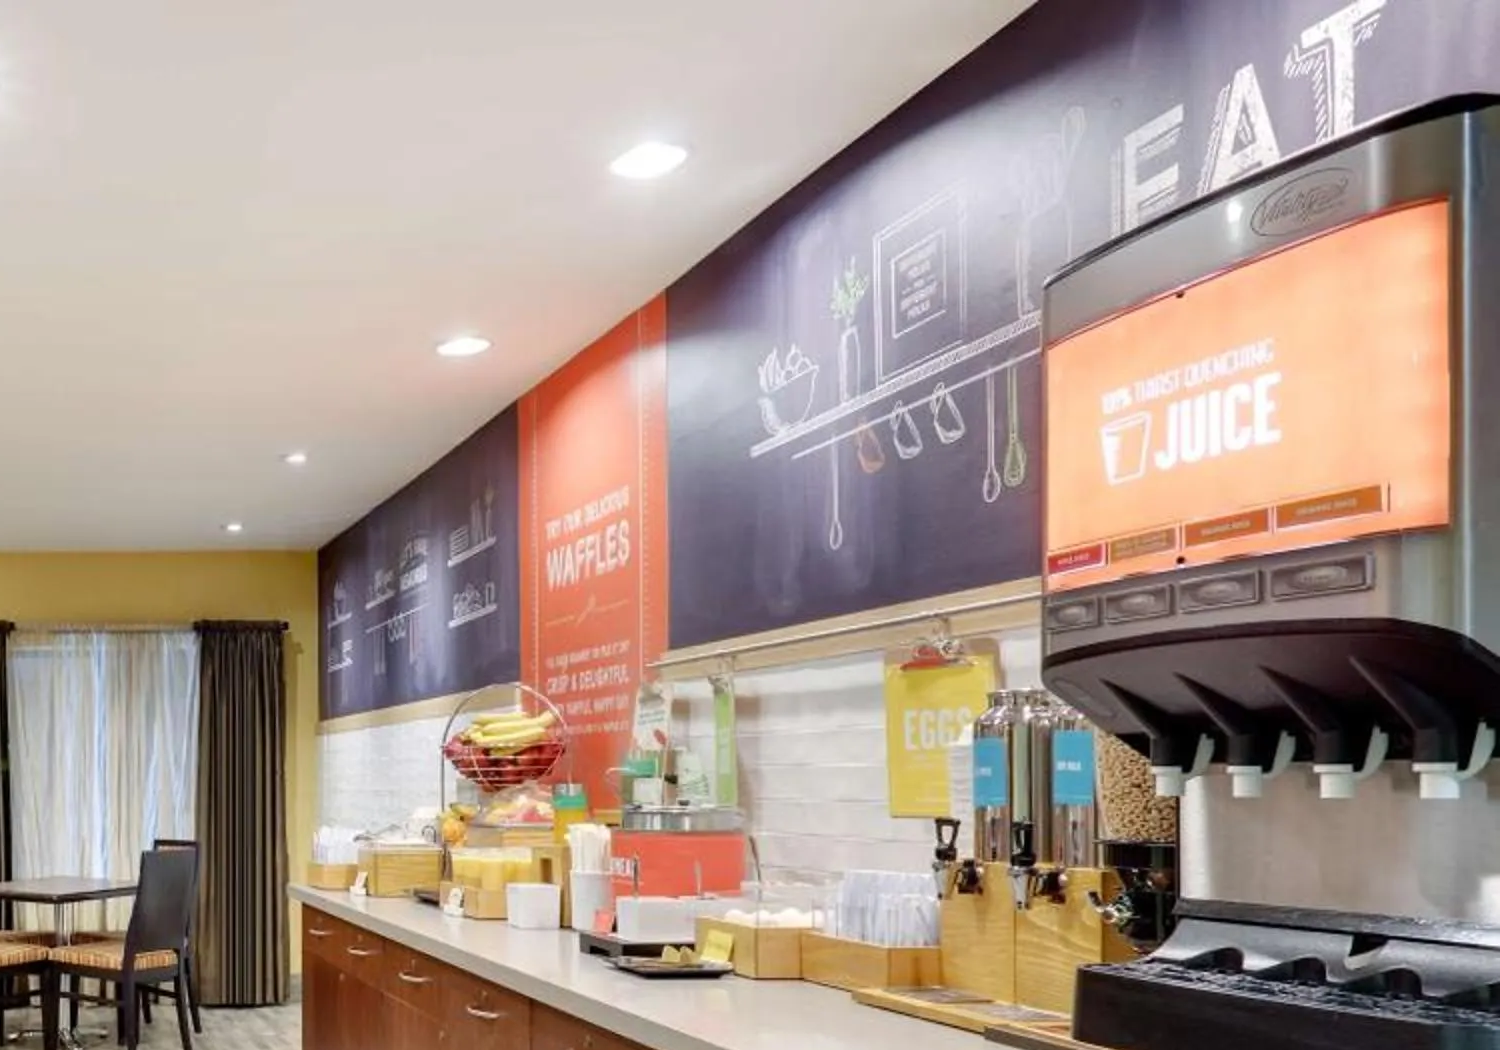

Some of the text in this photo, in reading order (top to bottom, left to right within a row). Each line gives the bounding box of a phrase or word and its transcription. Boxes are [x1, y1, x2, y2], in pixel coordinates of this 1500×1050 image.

[1112, 0, 1389, 236] EAT
[1133, 369, 1180, 402] THIRST
[1184, 337, 1275, 387] QUENCHING
[1155, 372, 1282, 470] JUICE
[584, 485, 630, 528] DELICIOUS
[546, 518, 630, 592] WAFFLES
[904, 706, 973, 750] EGGS
